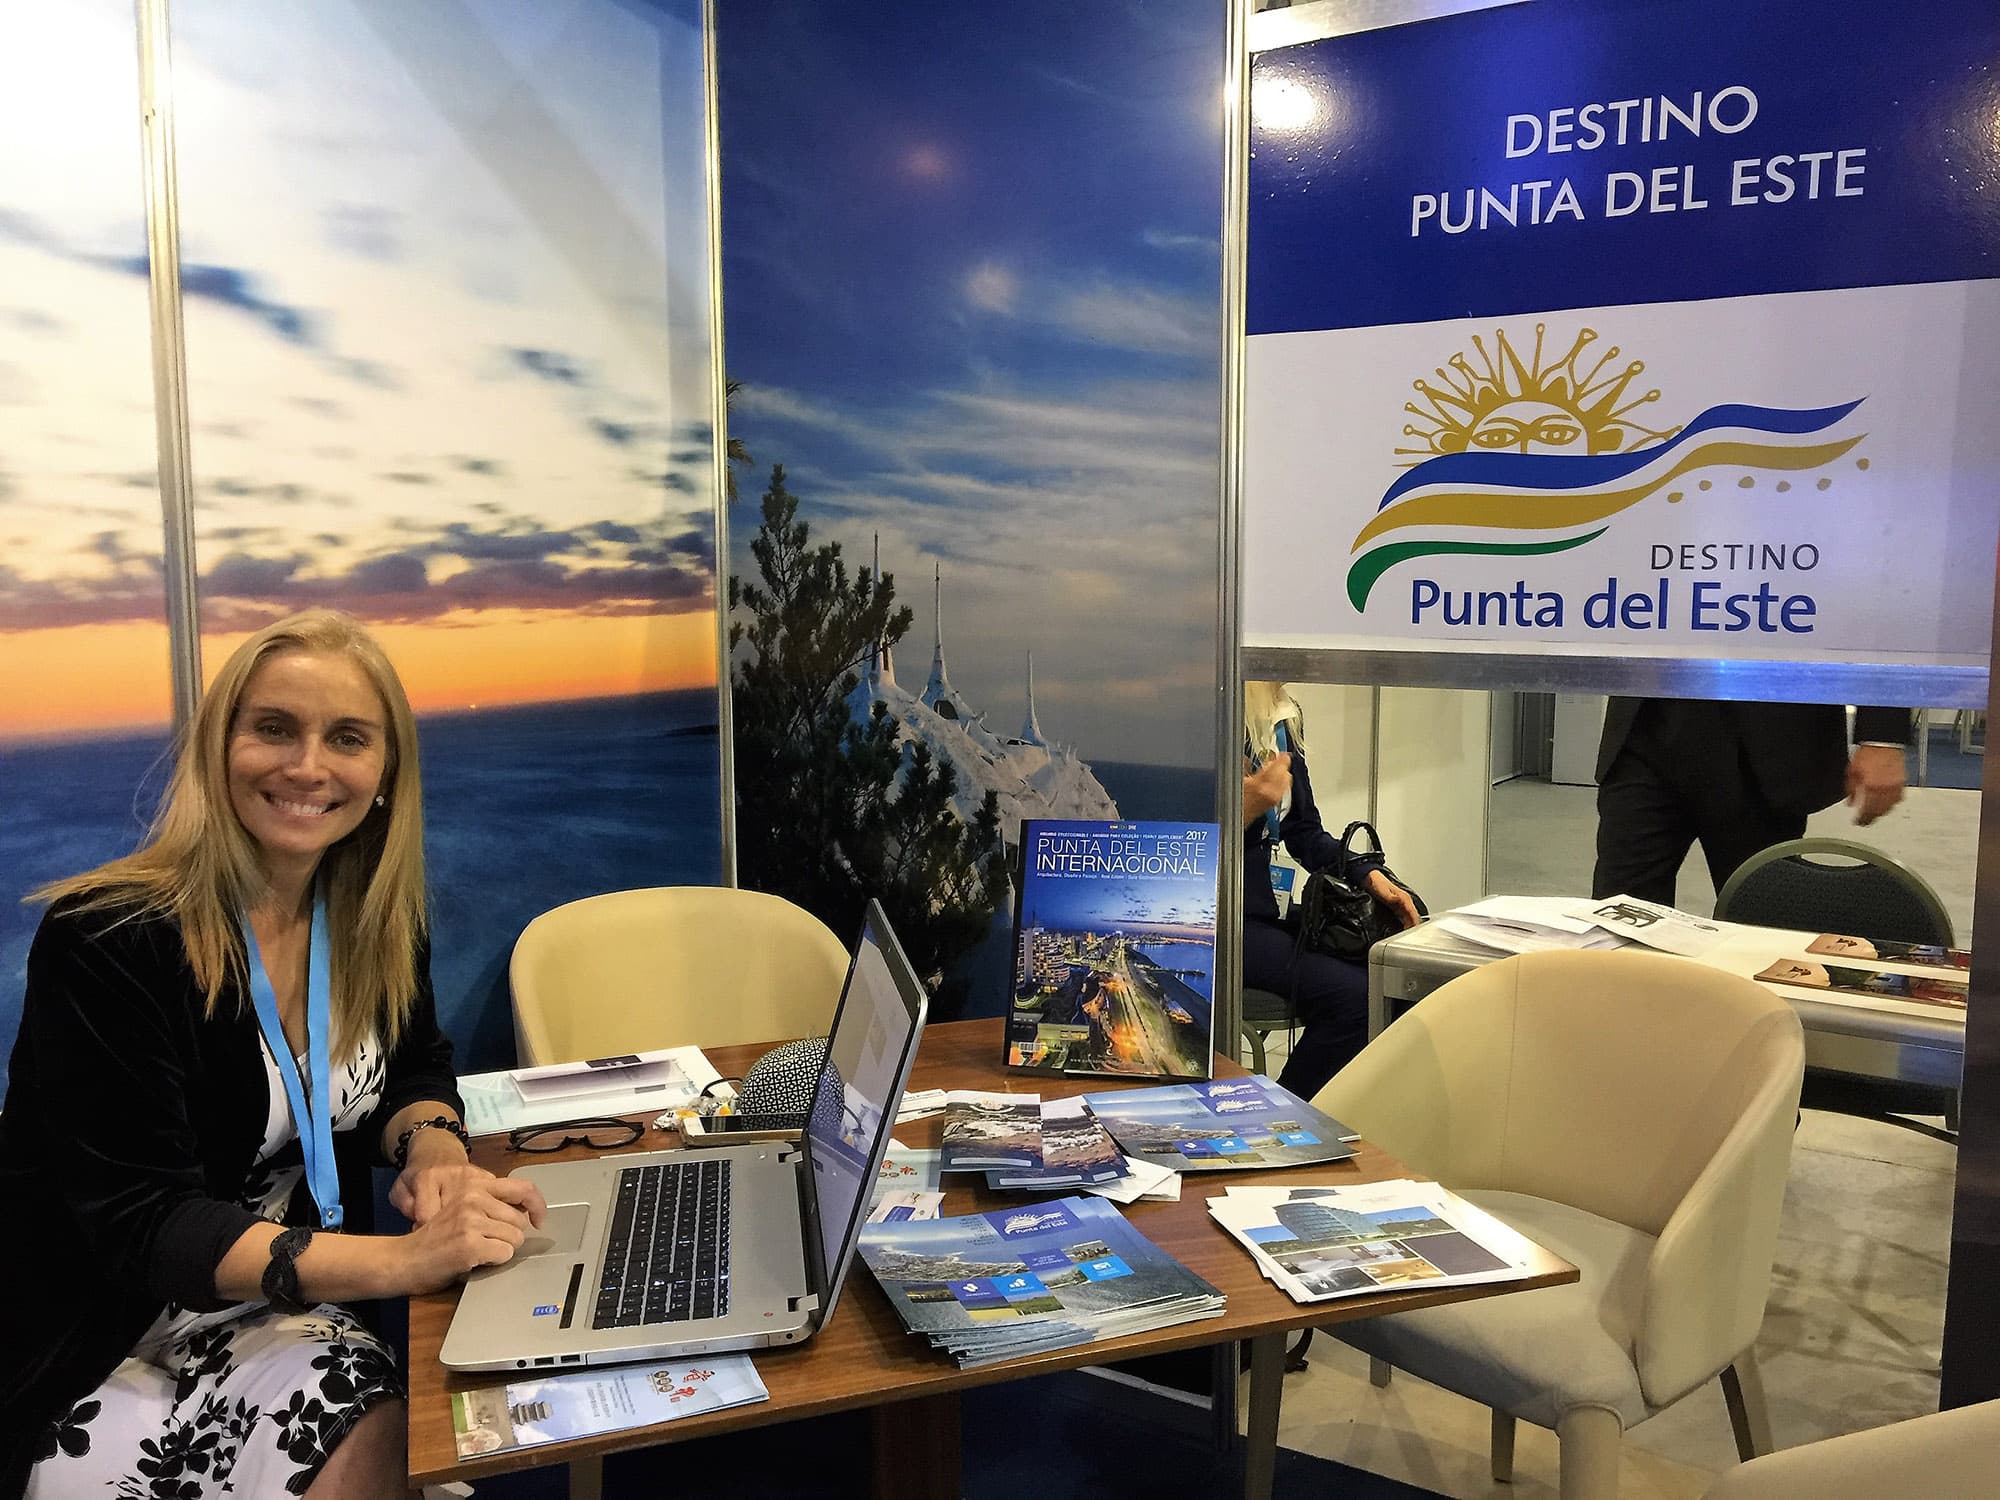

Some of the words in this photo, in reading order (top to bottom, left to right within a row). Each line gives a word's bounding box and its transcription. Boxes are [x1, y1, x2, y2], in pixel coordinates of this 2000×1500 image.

[1505, 85, 1759, 160] DESTINO
[1411, 177, 1585, 237] PUNTA
[1605, 164, 1709, 218] DEL
[1731, 148, 1867, 206] ESTE
[1650, 543, 1820, 571] DESTINO
[1411, 579, 1564, 628] Punta
[1583, 577, 1669, 630] del
[1691, 581, 1817, 634] Este
[1038, 838, 1102, 855] PUNTA
[1110, 840, 1147, 856] DEL
[1156, 841, 1207, 858] ESTE
[1185, 830, 1208, 841] 2017
[1037, 853, 1206, 875] INTERNACIONAL
